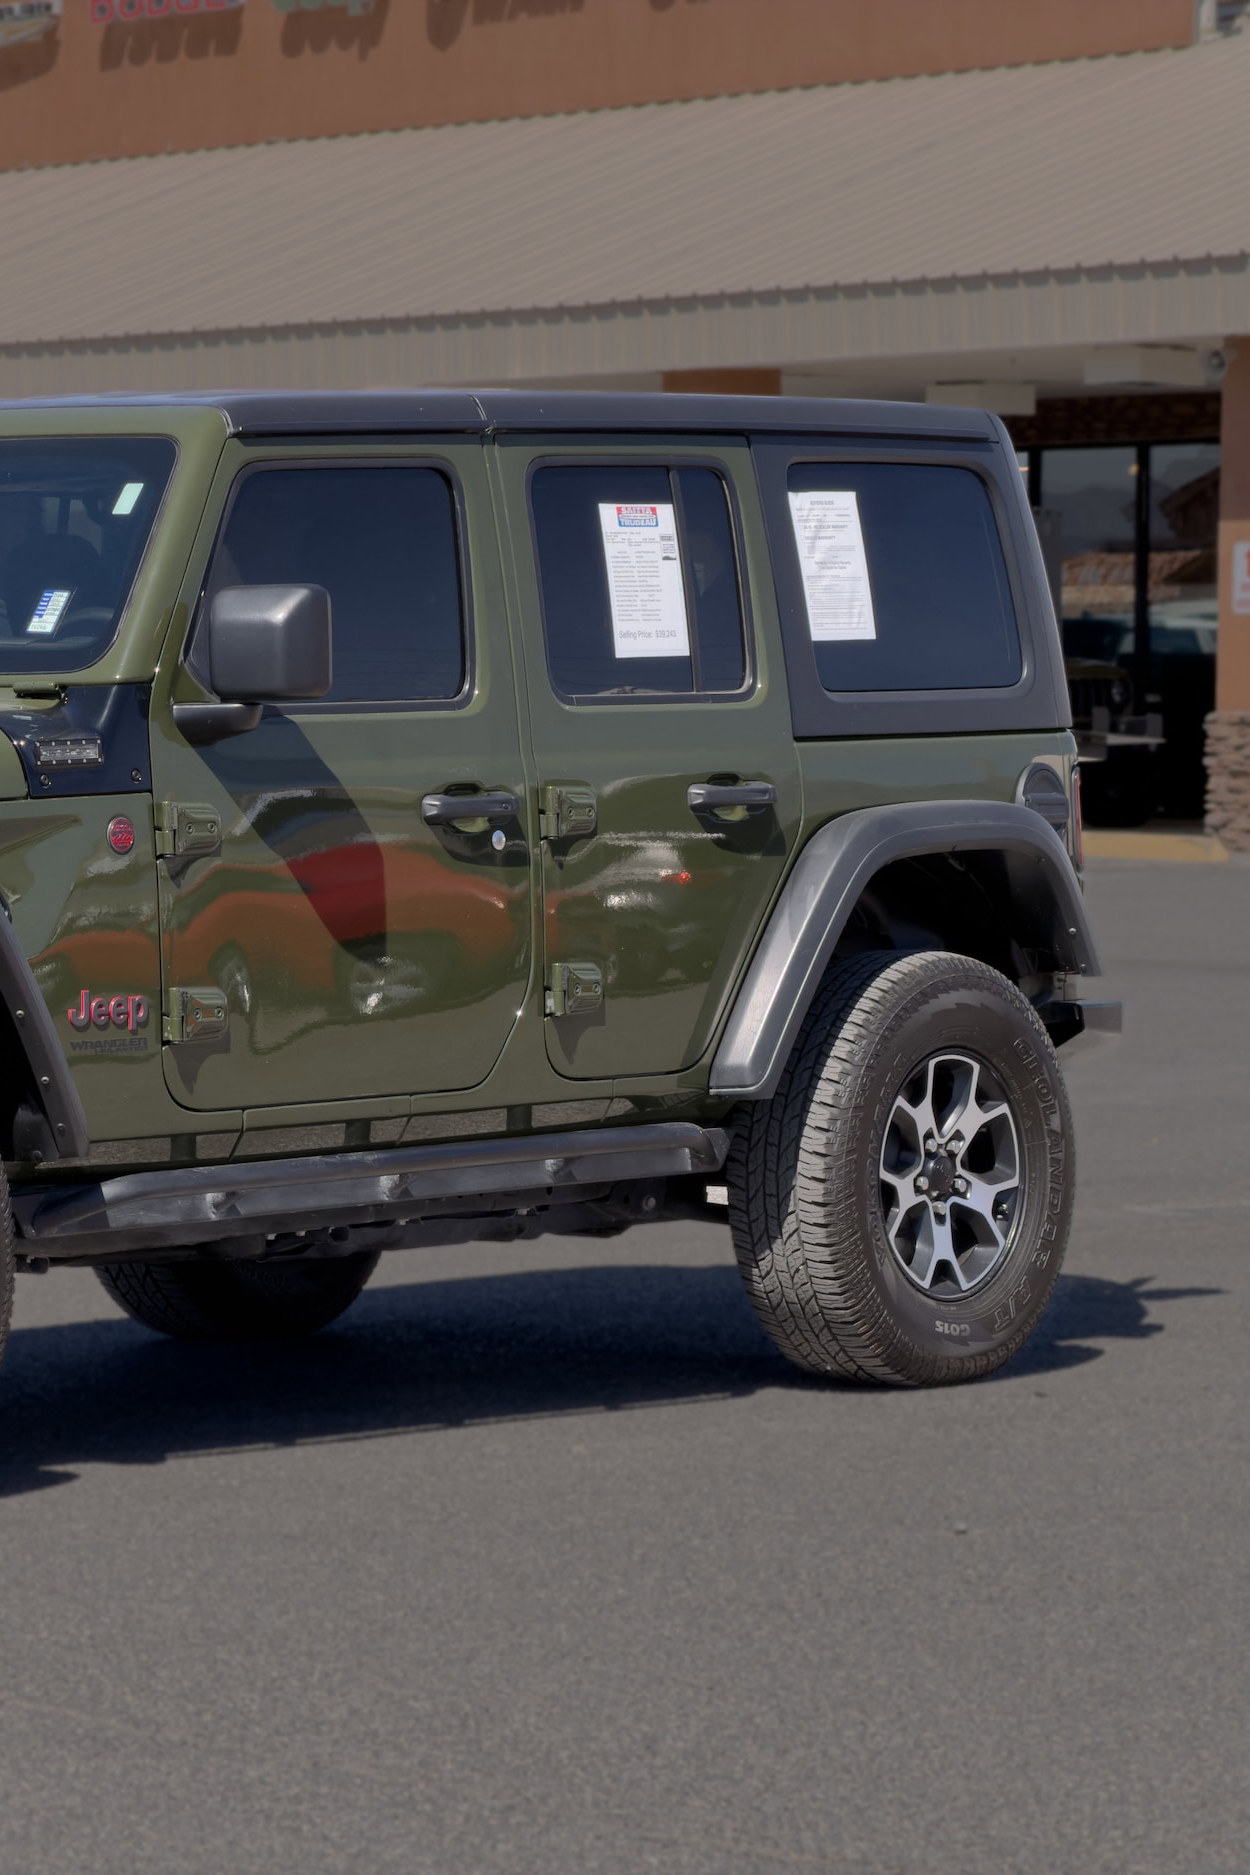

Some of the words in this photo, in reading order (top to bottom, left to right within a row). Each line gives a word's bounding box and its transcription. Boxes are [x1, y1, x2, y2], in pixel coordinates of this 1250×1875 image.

[90, 0, 227, 24] DODG
[619, 518, 657, 526] TRUDEAU
[618, 630, 637, 640] Selling
[67, 989, 149, 1033] Jeep
[70, 1037, 148, 1051] WRANGLER
[1013, 1038, 1064, 1271] GEOLANDAR
[934, 1320, 972, 1337] G015
